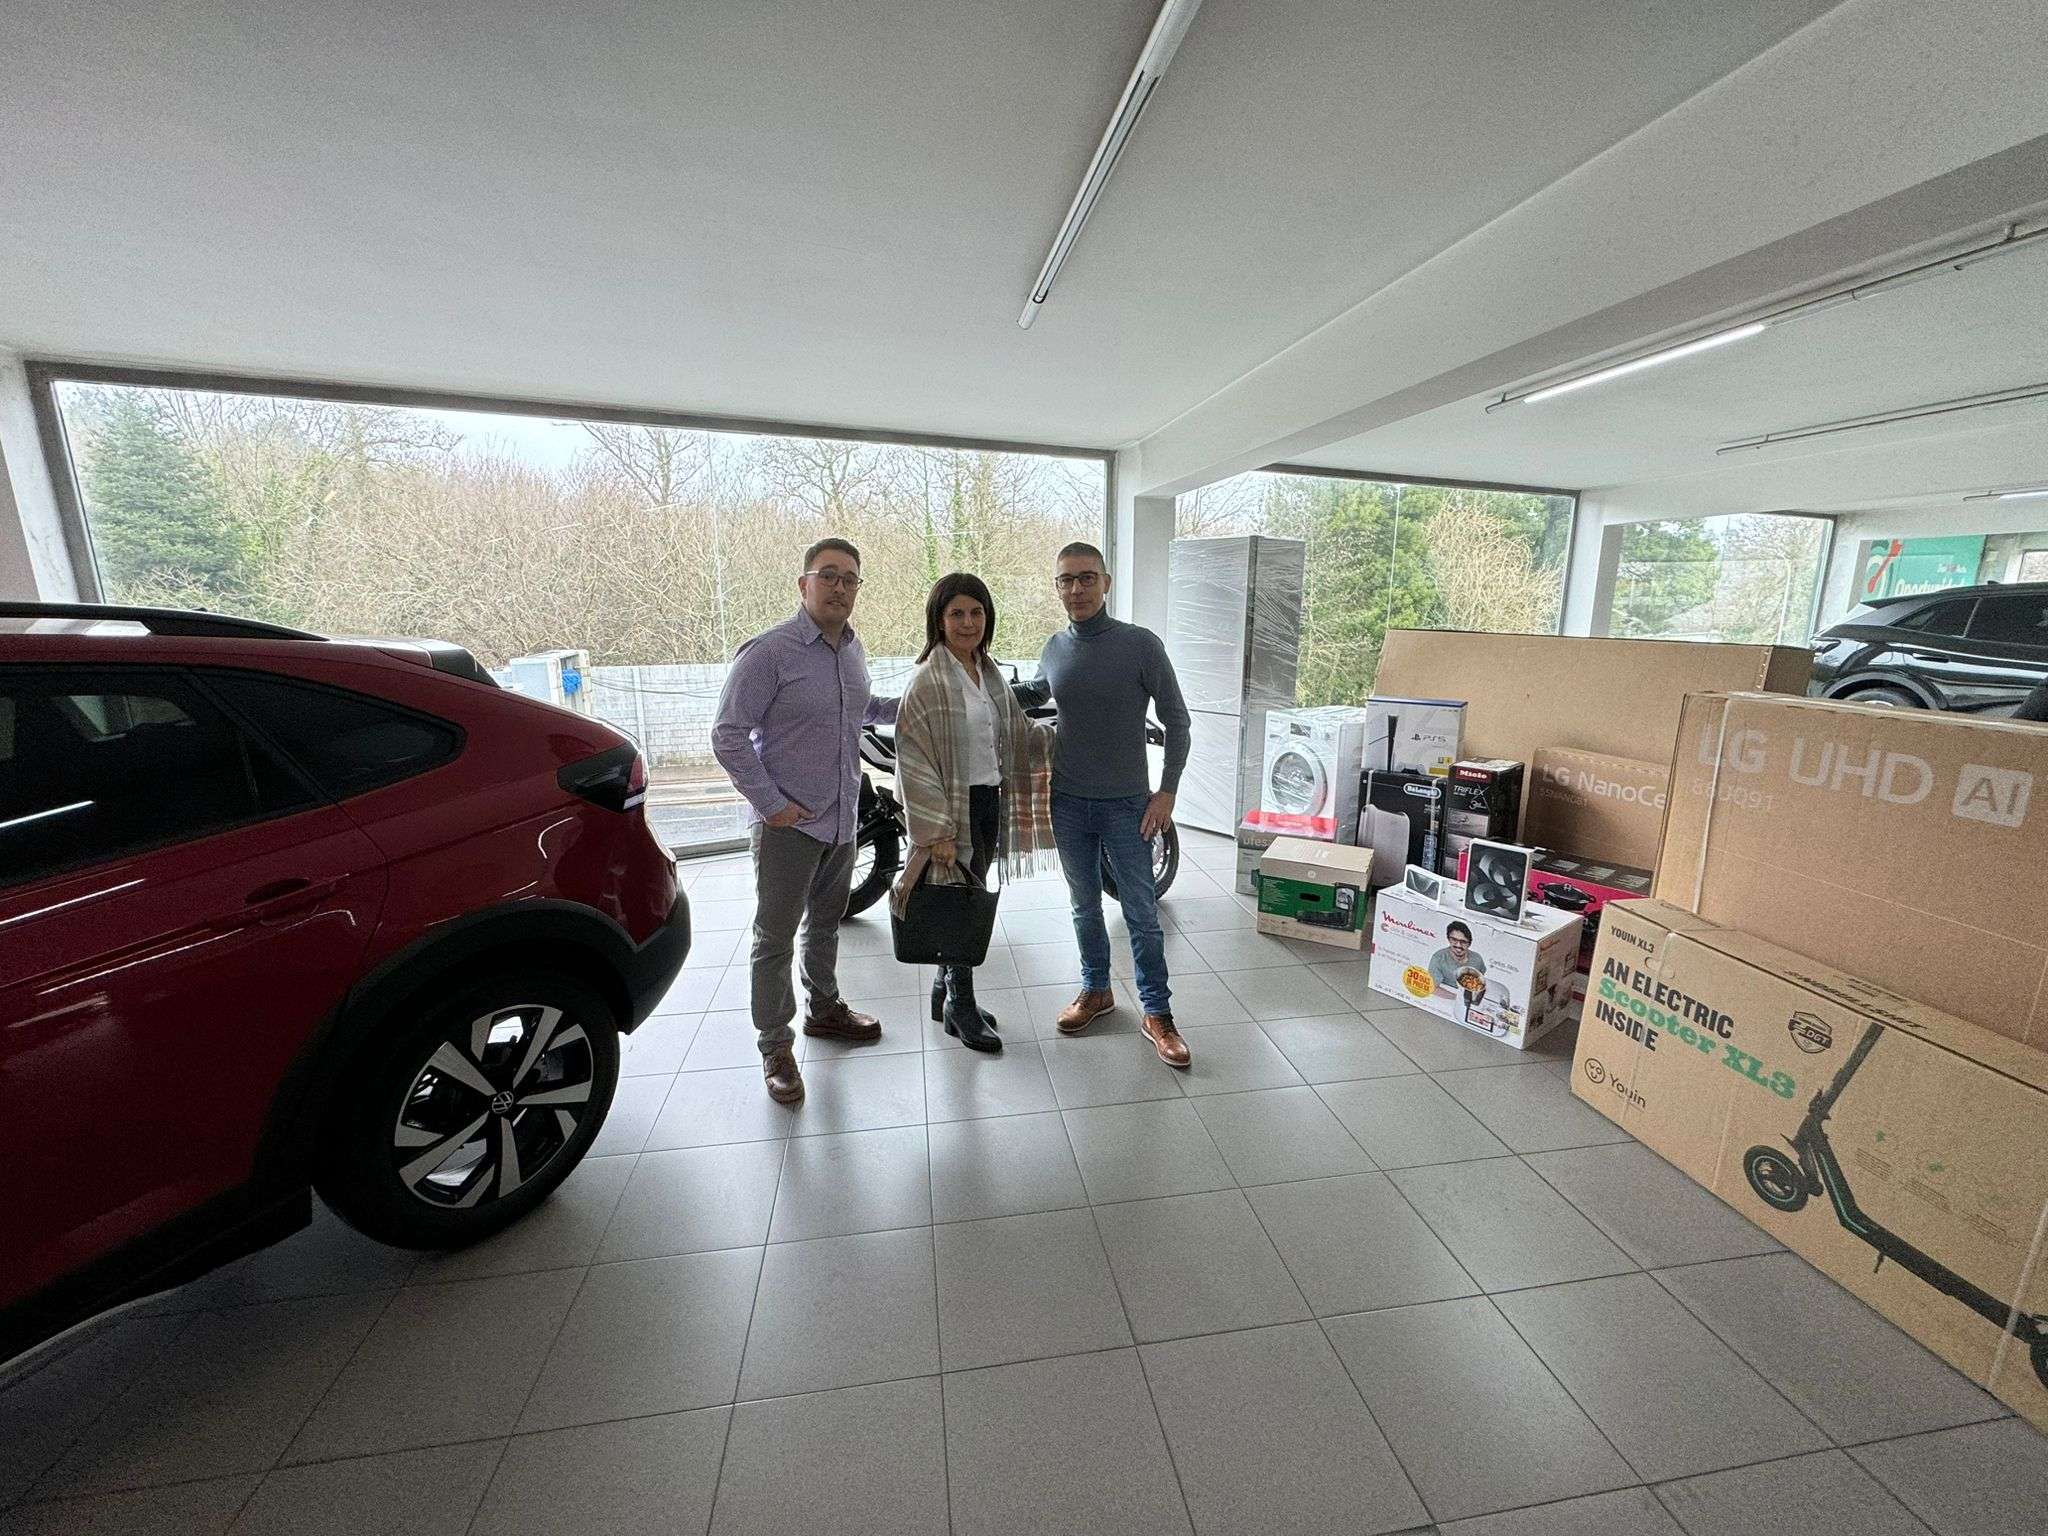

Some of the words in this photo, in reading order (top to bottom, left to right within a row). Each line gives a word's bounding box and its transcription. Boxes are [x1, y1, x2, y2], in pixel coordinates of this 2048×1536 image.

[1541, 763, 1570, 787] LG
[1698, 722, 1768, 774] LG
[1789, 735, 1934, 804] UHD
[1961, 777, 2020, 815] AI
[1611, 925, 1637, 946] YOUIN
[1638, 937, 1655, 954] XL3
[1603, 957, 1630, 985] AN
[1631, 970, 1734, 1039] ELECTRIC
[1595, 999, 1659, 1052] INSIDE
[1599, 976, 1717, 1055] Scooter
[1721, 1042, 1797, 1099] XL3
[1806, 1030, 1830, 1046] DGT
[1609, 1073, 1646, 1108] Youin
